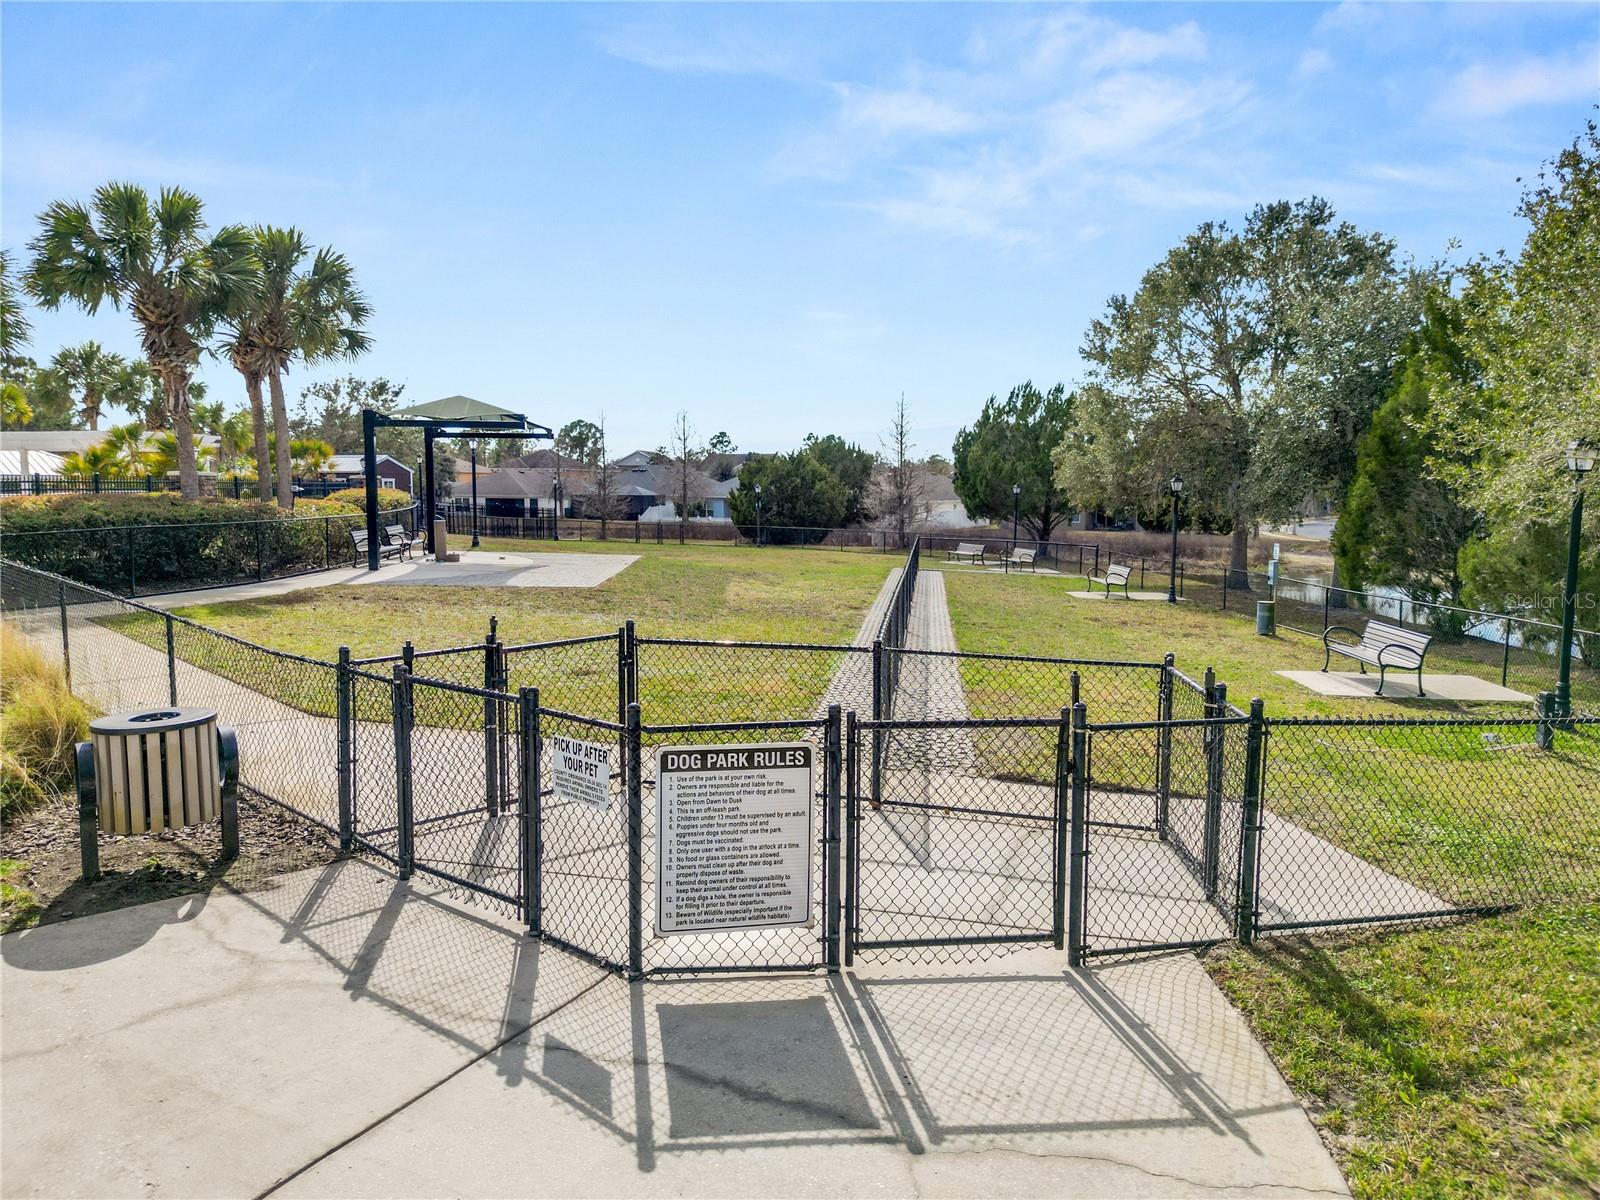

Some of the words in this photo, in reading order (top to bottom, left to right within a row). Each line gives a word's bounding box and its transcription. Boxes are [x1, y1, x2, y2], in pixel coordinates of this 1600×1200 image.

[554, 736, 570, 754] PICK
[573, 742, 582, 757] UP
[584, 745, 607, 765] AFTER
[668, 754, 701, 769] DOG
[707, 752, 748, 768] PARK
[754, 750, 804, 766] RULES
[563, 755, 583, 774] YOUR
[585, 762, 598, 778] PET
[747, 812, 776, 820] supervised
[676, 831, 704, 839] aggressive
[676, 871, 698, 880] properly
[700, 870, 720, 878] dispose
[749, 874, 784, 883] responsibility
[762, 889, 791, 898] responsible
[754, 905, 778, 914] important
